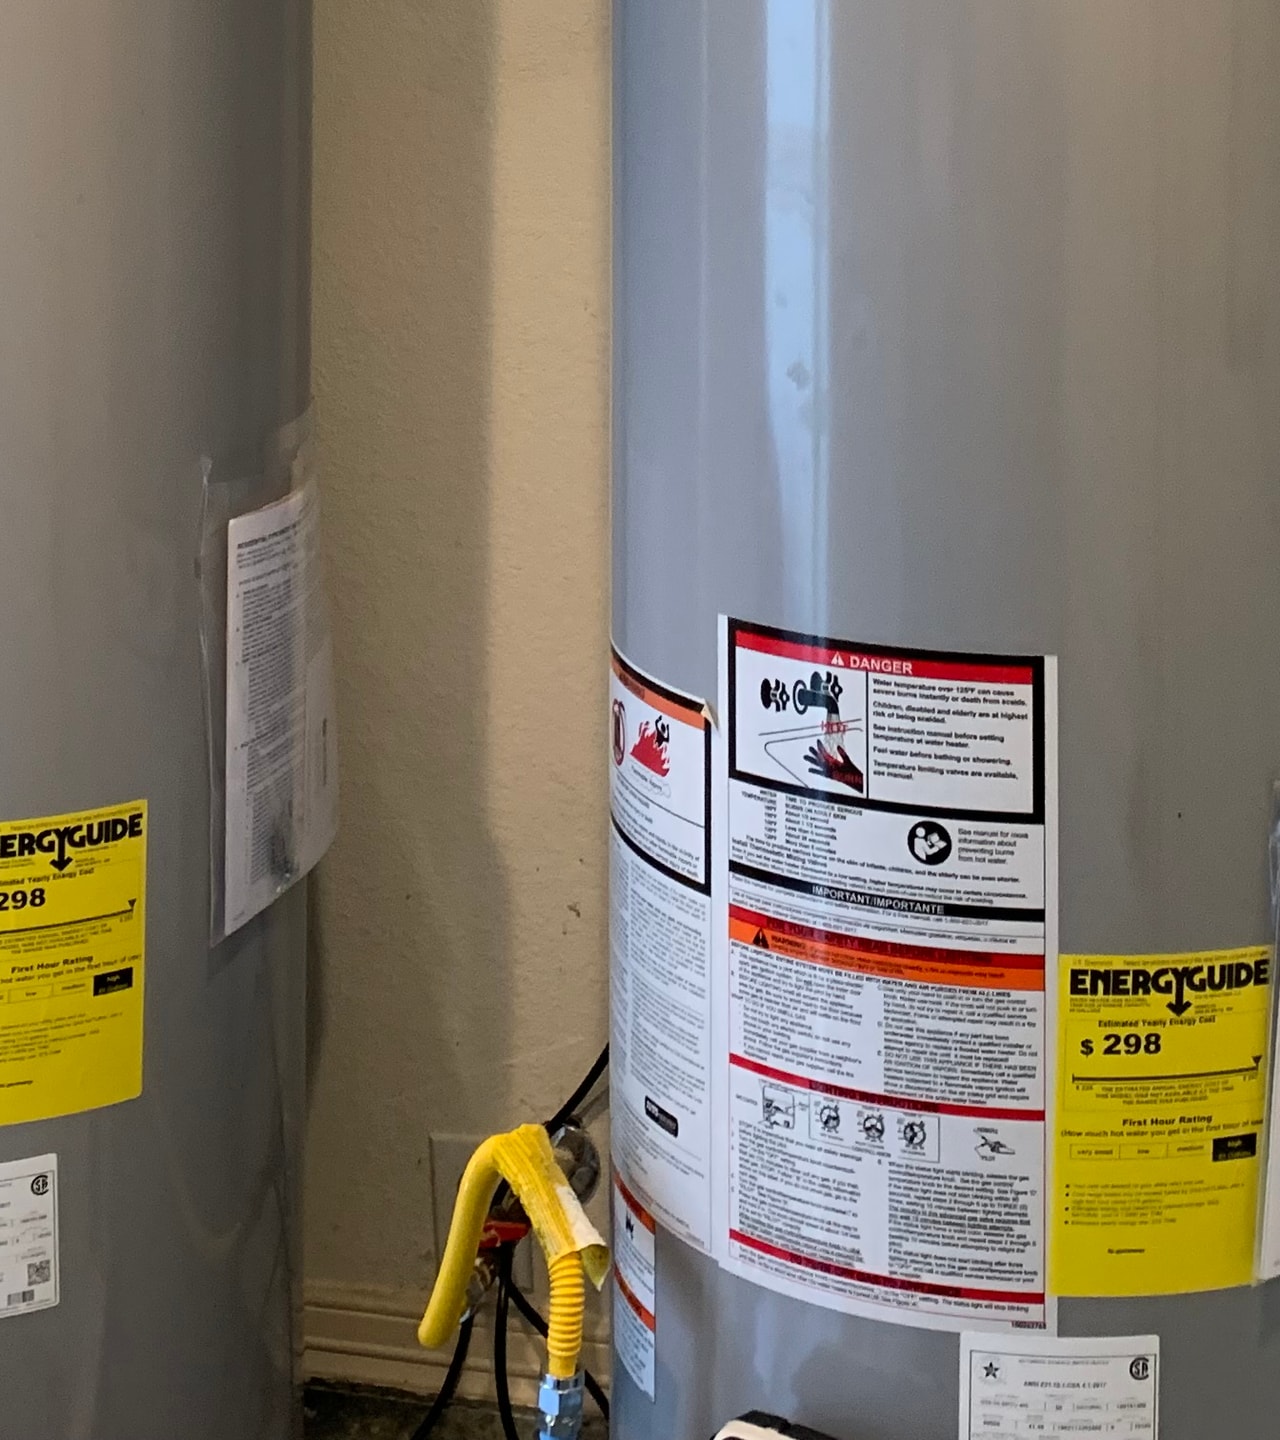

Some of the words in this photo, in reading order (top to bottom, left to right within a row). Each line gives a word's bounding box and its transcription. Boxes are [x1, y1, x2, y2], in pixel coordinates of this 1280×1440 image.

[849, 655, 913, 675] DANGER
[812, 885, 945, 915] IMPORTANT/IMPORTANTE
[11, 965, 33, 974] First
[37, 962, 60, 971] Hour
[63, 955, 94, 966] Rating
[1070, 959, 1270, 1006] ENERGYGUIDE
[1080, 1038, 1094, 1058] $
[1102, 1033, 1161, 1055] 298
[1122, 1118, 1147, 1127] First
[1179, 1115, 1213, 1125] Rating
